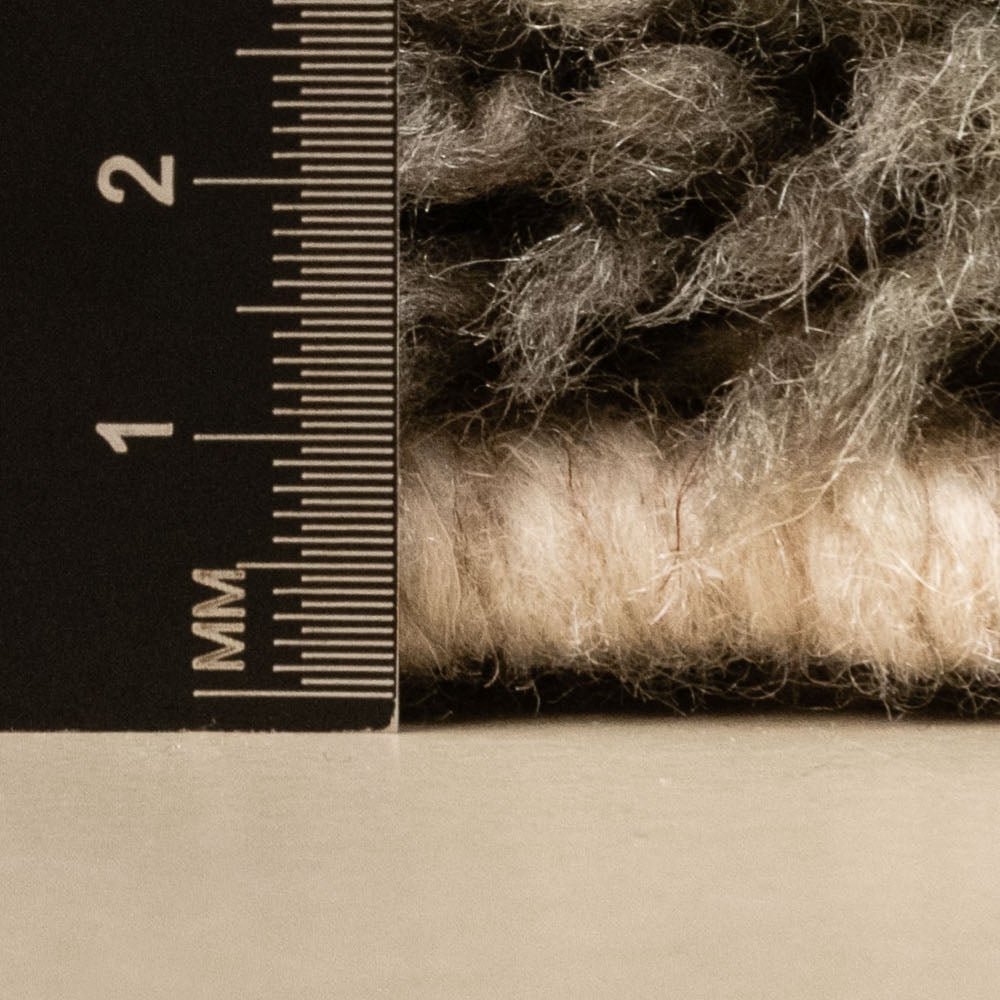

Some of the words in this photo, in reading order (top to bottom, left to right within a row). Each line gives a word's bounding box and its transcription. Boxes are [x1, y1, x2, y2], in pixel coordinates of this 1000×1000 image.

[96, 154, 175, 206] 2
[95, 422, 174, 453] 1
[191, 568, 246, 671] MM
